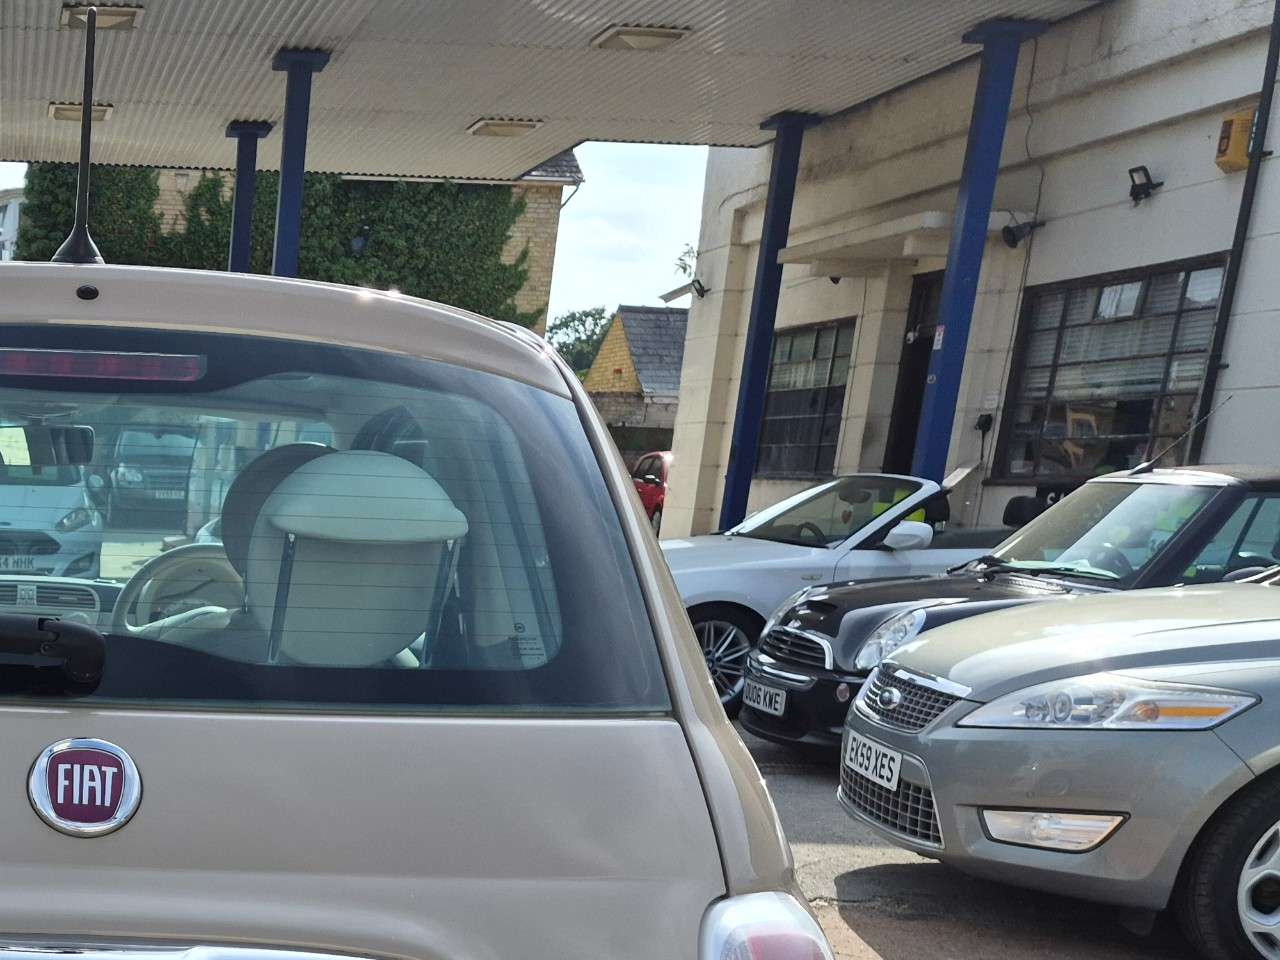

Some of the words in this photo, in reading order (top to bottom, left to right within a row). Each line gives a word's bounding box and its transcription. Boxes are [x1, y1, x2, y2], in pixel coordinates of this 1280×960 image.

[849, 736, 872, 771] EK59
[872, 748, 896, 783] XES
[57, 763, 118, 807] FIAT
